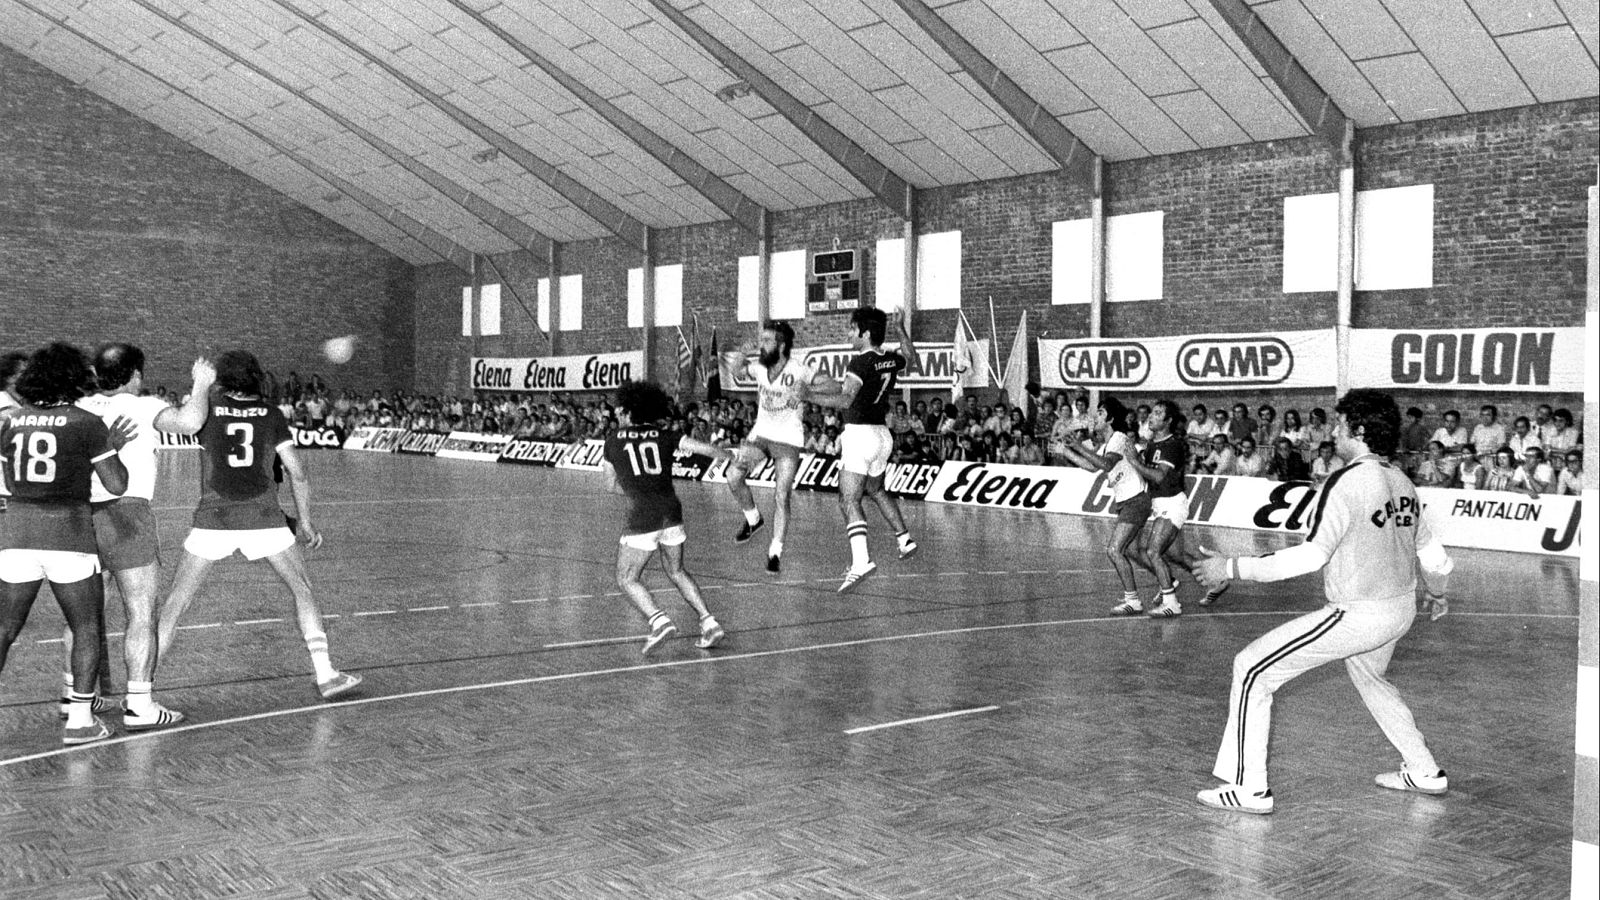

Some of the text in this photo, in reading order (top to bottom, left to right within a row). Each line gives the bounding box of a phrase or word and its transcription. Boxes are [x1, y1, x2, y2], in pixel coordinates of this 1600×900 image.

[474, 356, 631, 389] Elena Elena Elena
[1064, 345, 1284, 379] CAMP CAMP
[1391, 333, 1554, 385] COLON
[780, 373, 795, 386] 10
[873, 372, 891, 404] 7
[10, 415, 67, 428] MARIO
[215, 406, 268, 417] ALBIZU
[11, 431, 57, 483] 18
[227, 423, 254, 468] 3
[623, 442, 662, 476] 10
[944, 463, 1058, 509] Elena
[1451, 499, 1542, 522] PANTALON
